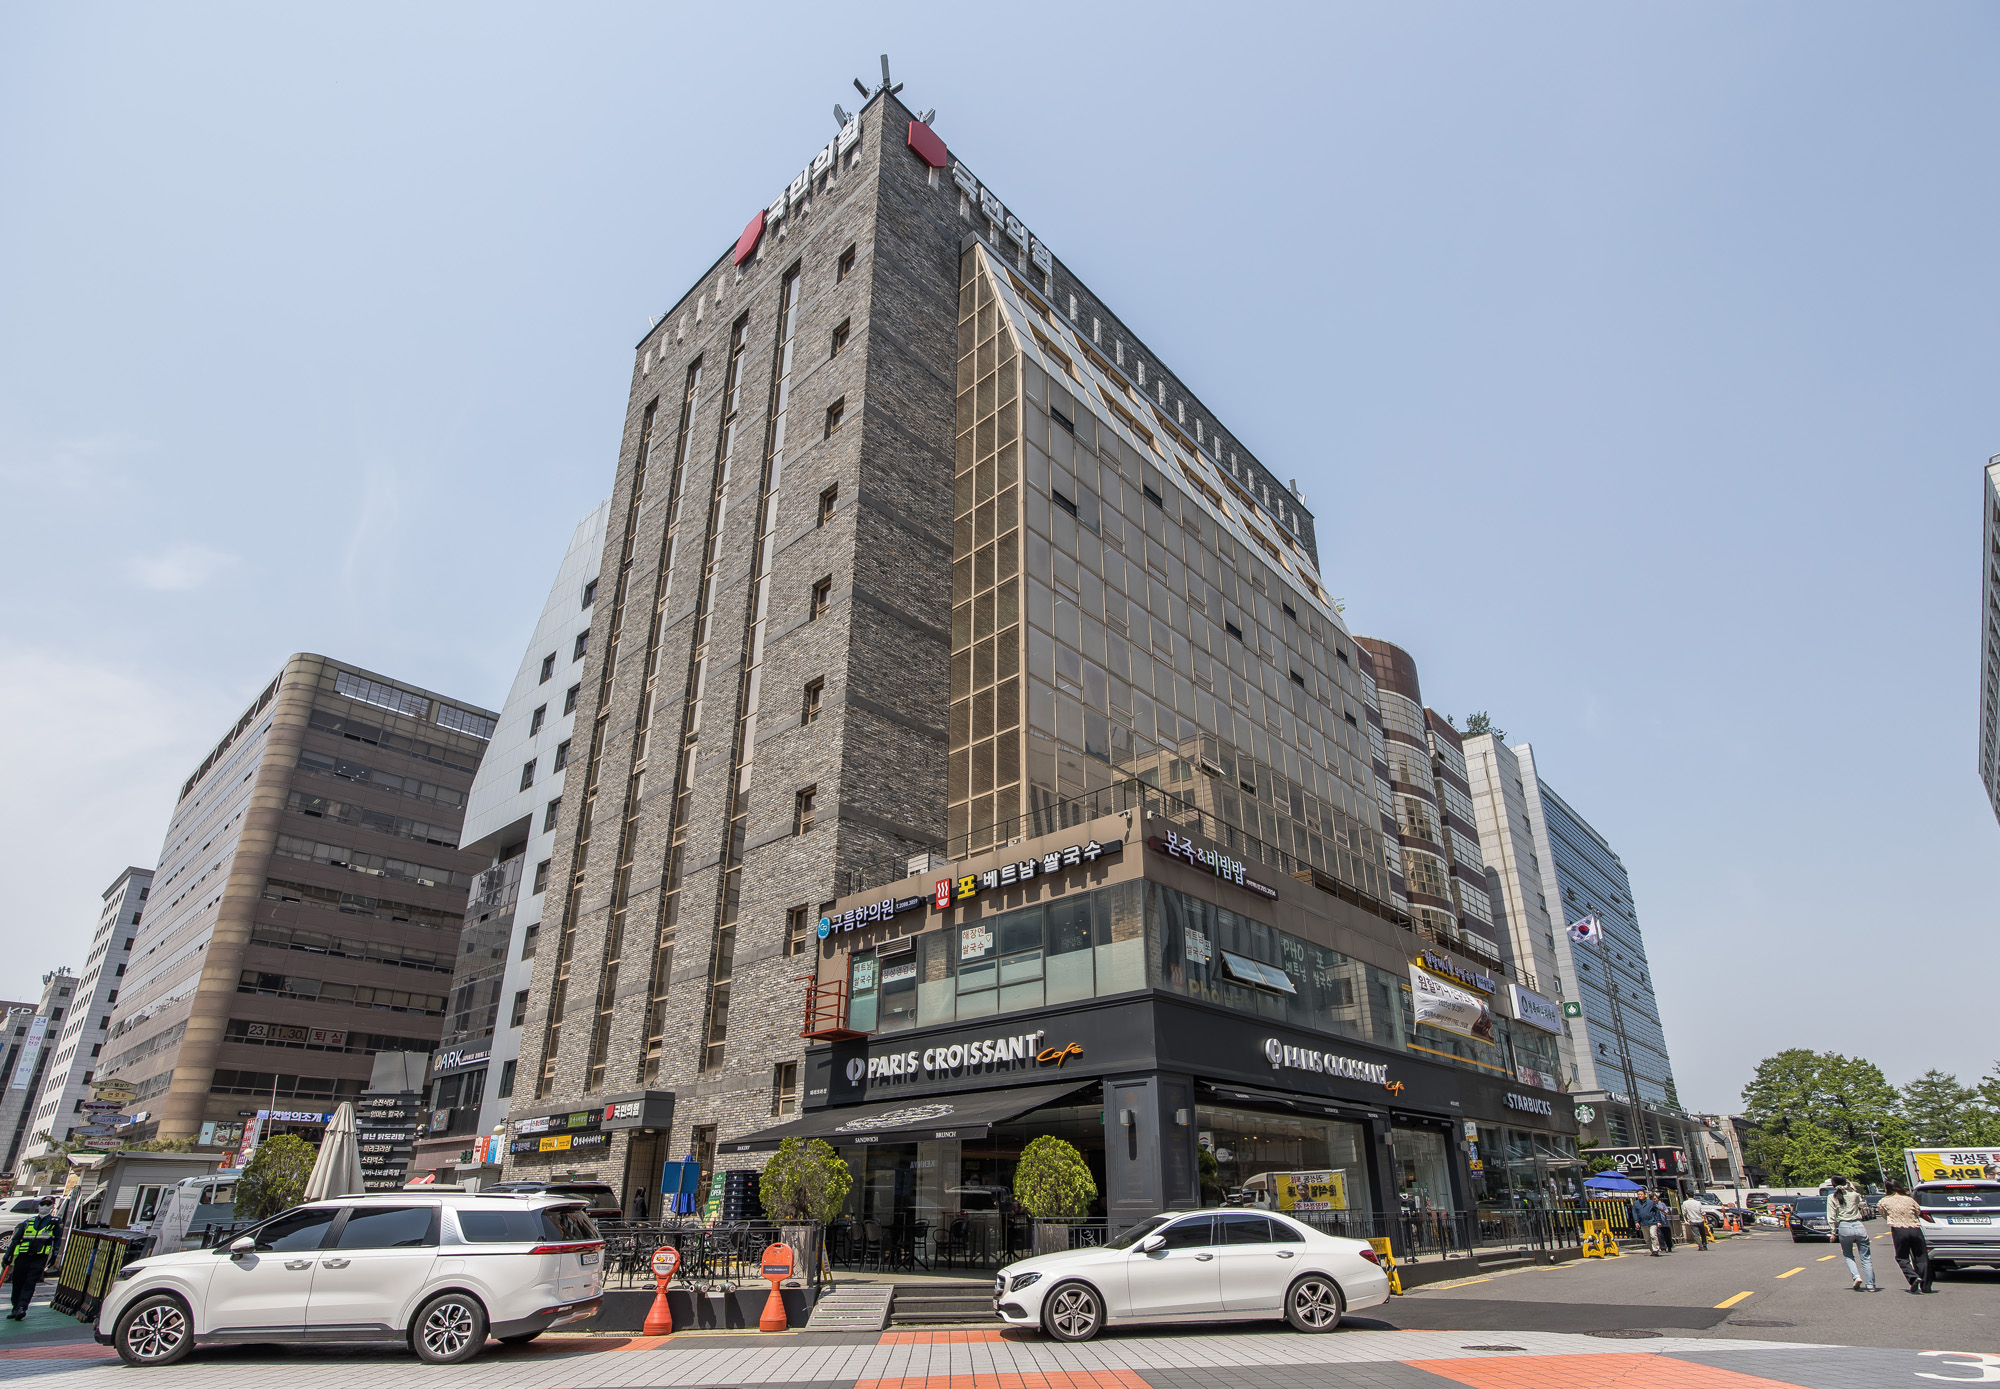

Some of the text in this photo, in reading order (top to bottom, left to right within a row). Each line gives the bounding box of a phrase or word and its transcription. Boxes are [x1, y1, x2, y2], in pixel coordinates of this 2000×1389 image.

[767, 112, 862, 225] 국민의힘
[953, 160, 1053, 277] 국민의힘
[1164, 829, 1247, 886] 본죽&비빔밥
[957, 840, 1102, 899] 포 베트남 쌀국수
[831, 898, 894, 934] 구름한의원
[961, 942, 985, 955] 쌀국수
[1186, 944, 1206, 960] 쌀국수
[1285, 960, 1307, 983] 베트남
[1313, 970, 1333, 992] 쌀국수
[249, 1025, 266, 1036] 23.
[271, 1028, 304, 1040] 11.30.
[867, 1051, 918, 1079] PARIS
[923, 1034, 1037, 1071] CROISSANT
[1283, 1045, 1323, 1073] PARIS
[1324, 1053, 1388, 1084] CROISSANT
[614, 1103, 639, 1119] 국민의힘
[1507, 1092, 1552, 1116] STARBUCKS
[1612, 1153, 1658, 1173] 울안심
[1950, 1154, 1989, 1164] 권성동
